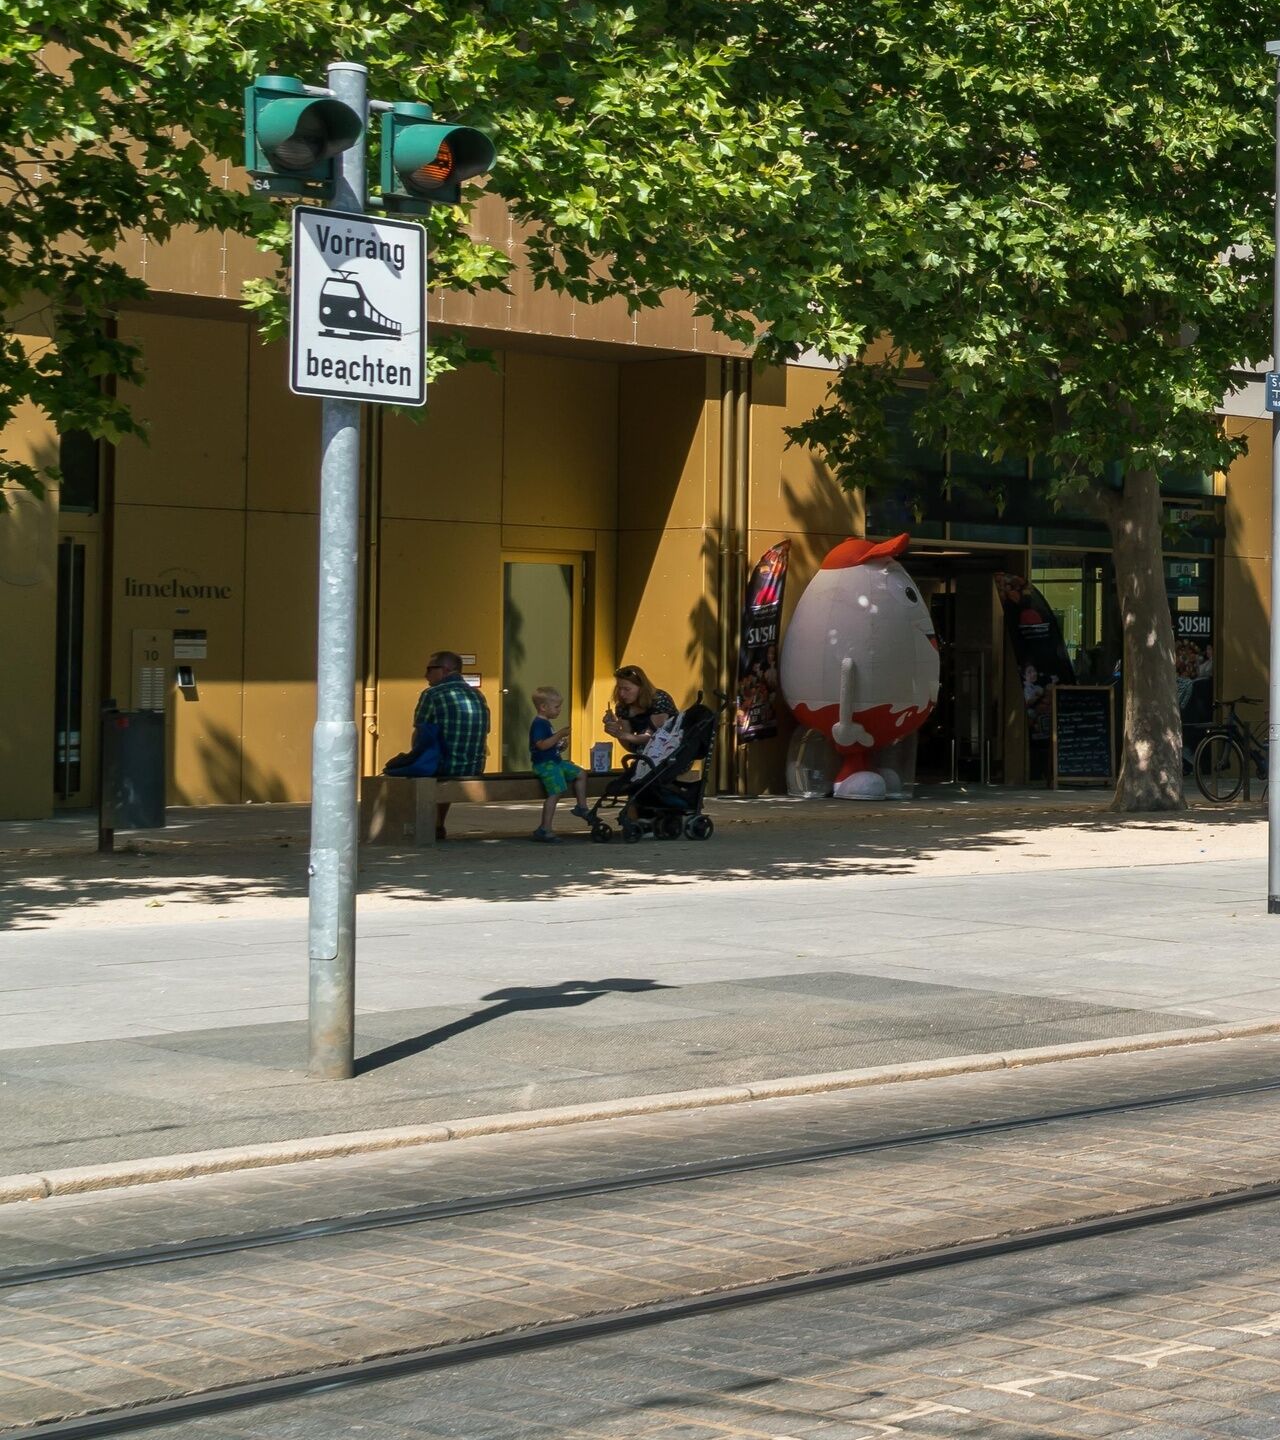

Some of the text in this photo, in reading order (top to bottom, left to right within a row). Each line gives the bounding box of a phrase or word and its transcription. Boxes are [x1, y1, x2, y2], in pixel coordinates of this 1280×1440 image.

[316, 224, 405, 271] Vorrang
[307, 349, 411, 386] beachten
[124, 577, 232, 599] limehome
[1178, 616, 1211, 633] SUSHI
[144, 650, 159, 661] 10
